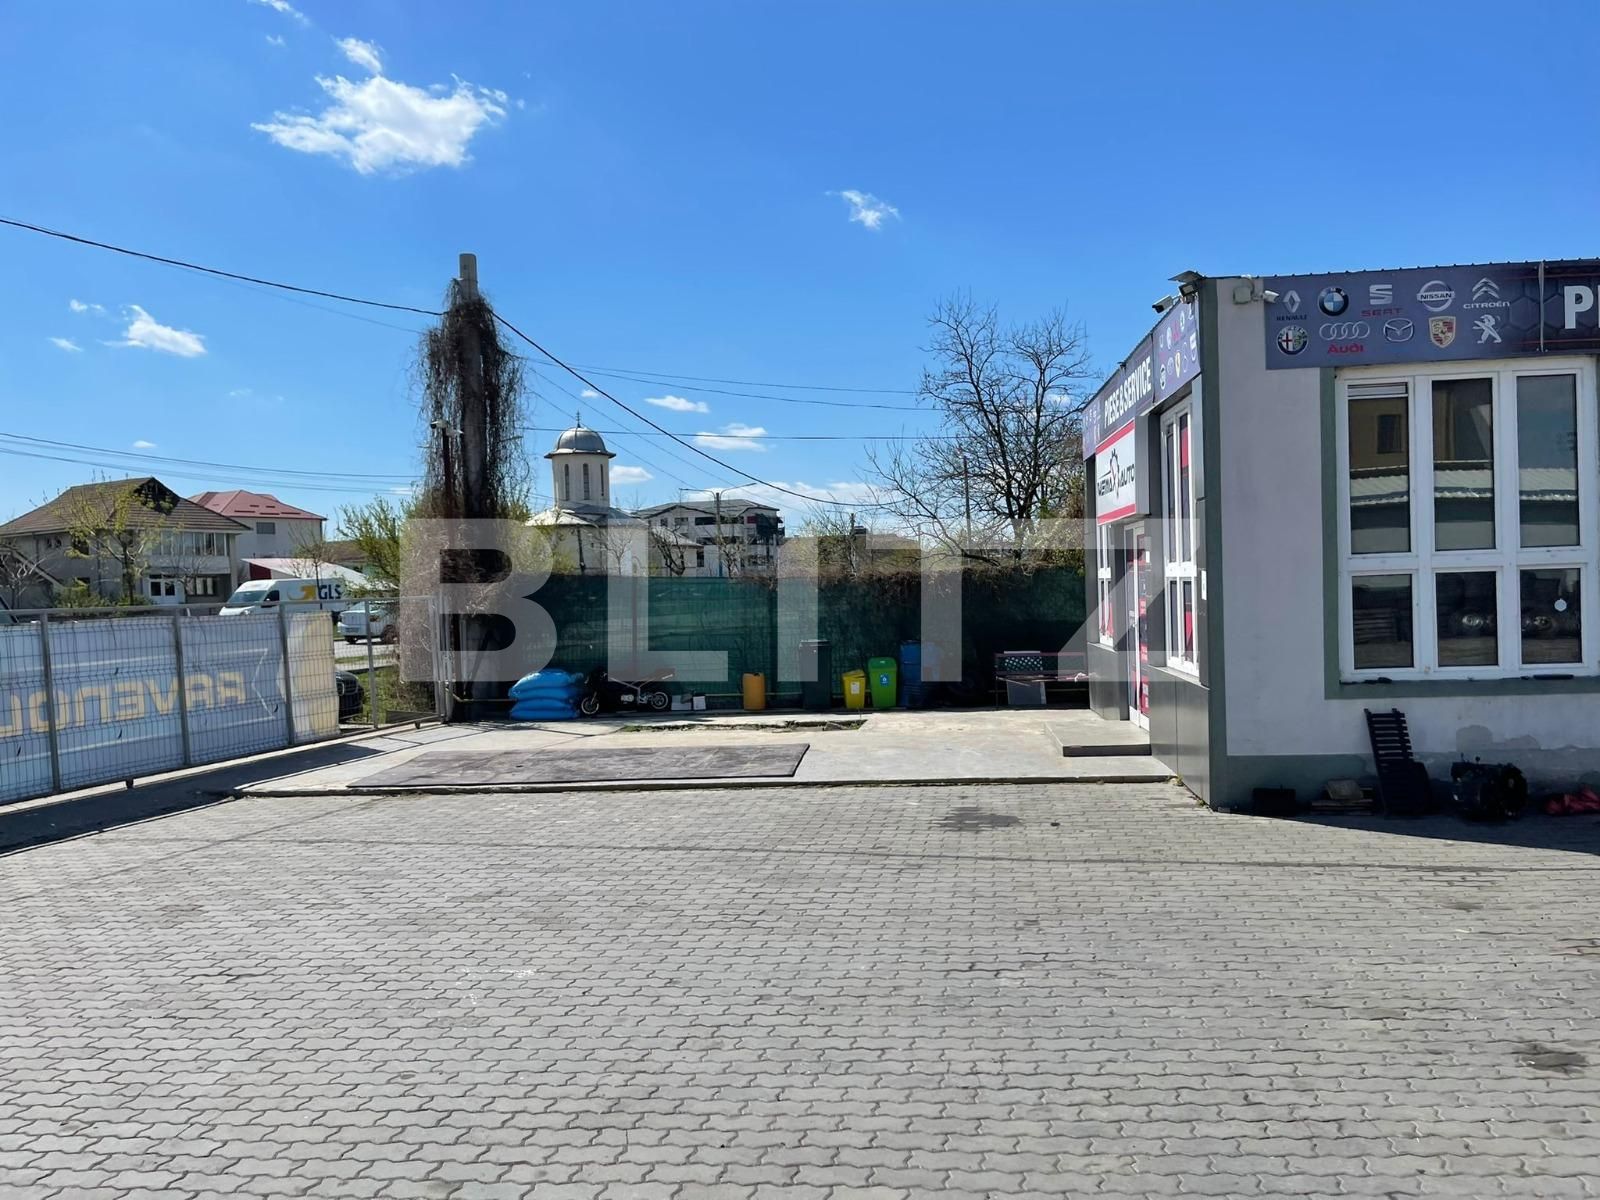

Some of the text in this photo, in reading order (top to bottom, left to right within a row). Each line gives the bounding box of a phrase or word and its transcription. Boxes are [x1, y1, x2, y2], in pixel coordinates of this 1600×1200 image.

[1360, 307, 1404, 317] SEAT
[1563, 285, 1600, 330] P
[318, 584, 341, 600] GLS
